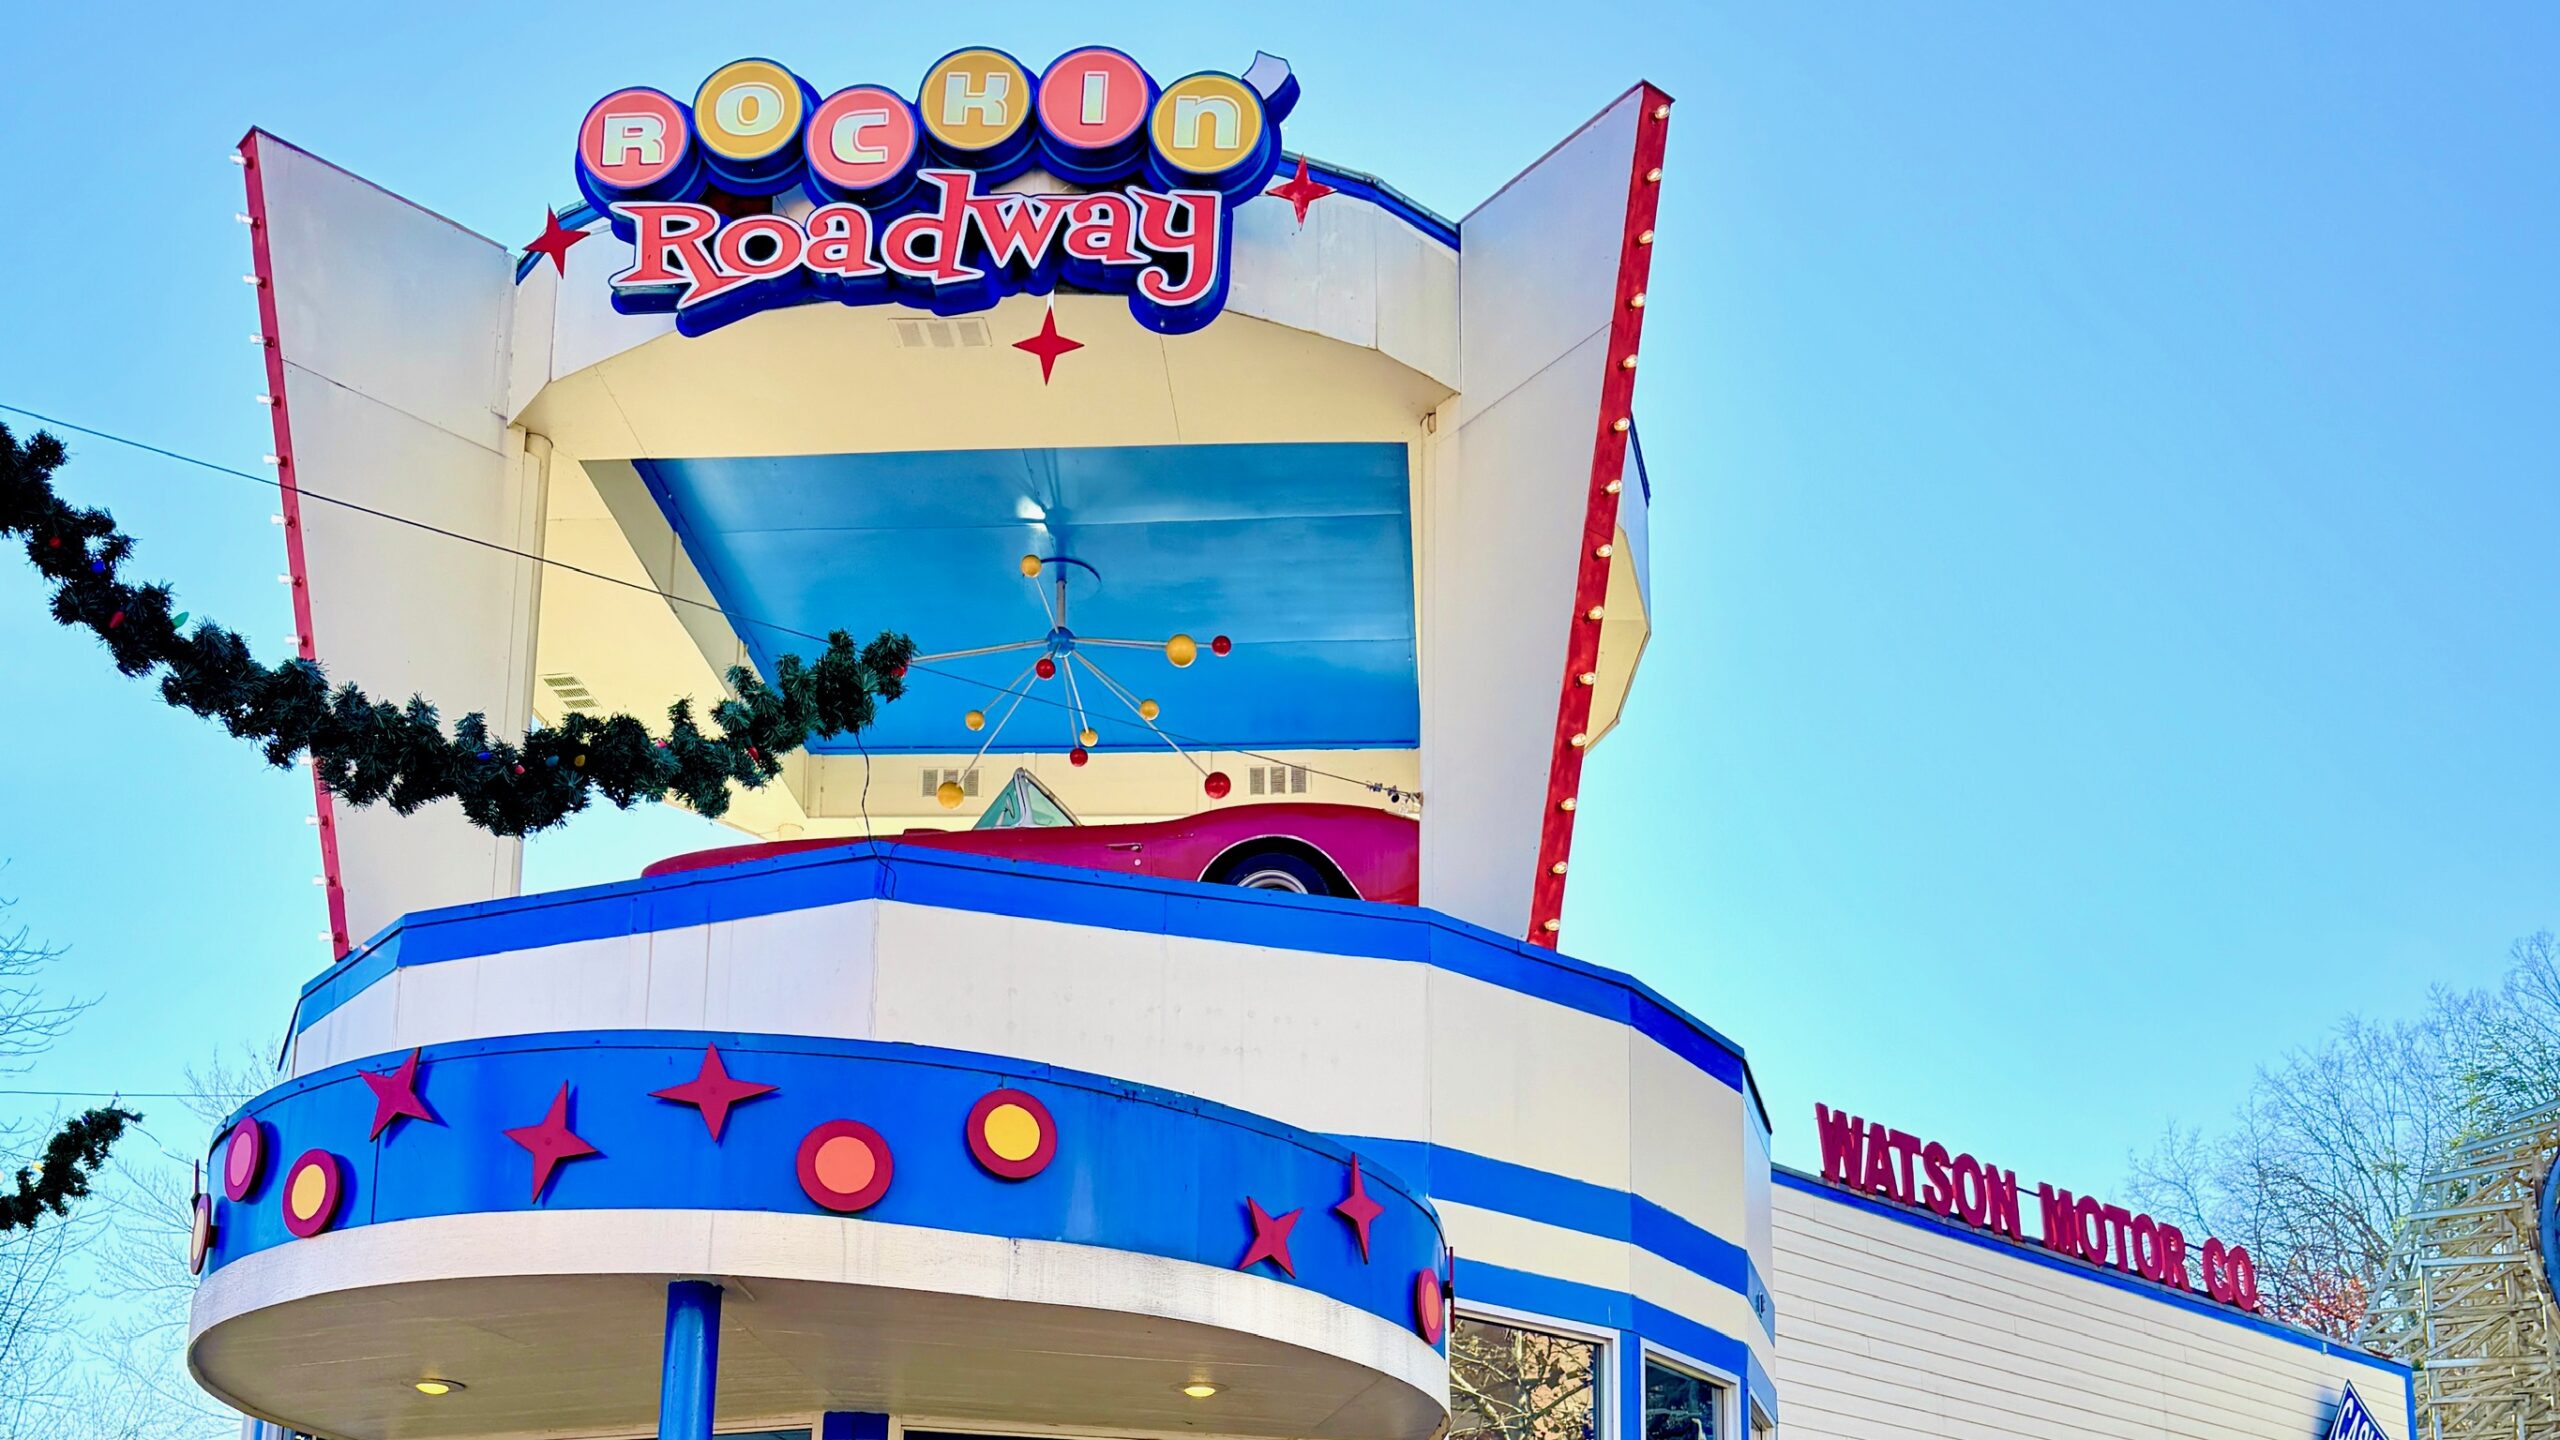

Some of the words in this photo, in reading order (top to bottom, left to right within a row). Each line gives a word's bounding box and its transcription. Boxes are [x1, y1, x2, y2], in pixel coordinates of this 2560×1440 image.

[609, 168, 1223, 308] Roadway
[1815, 1102, 2024, 1242] WATSON
[2039, 1182, 2191, 1293] MOTOR
